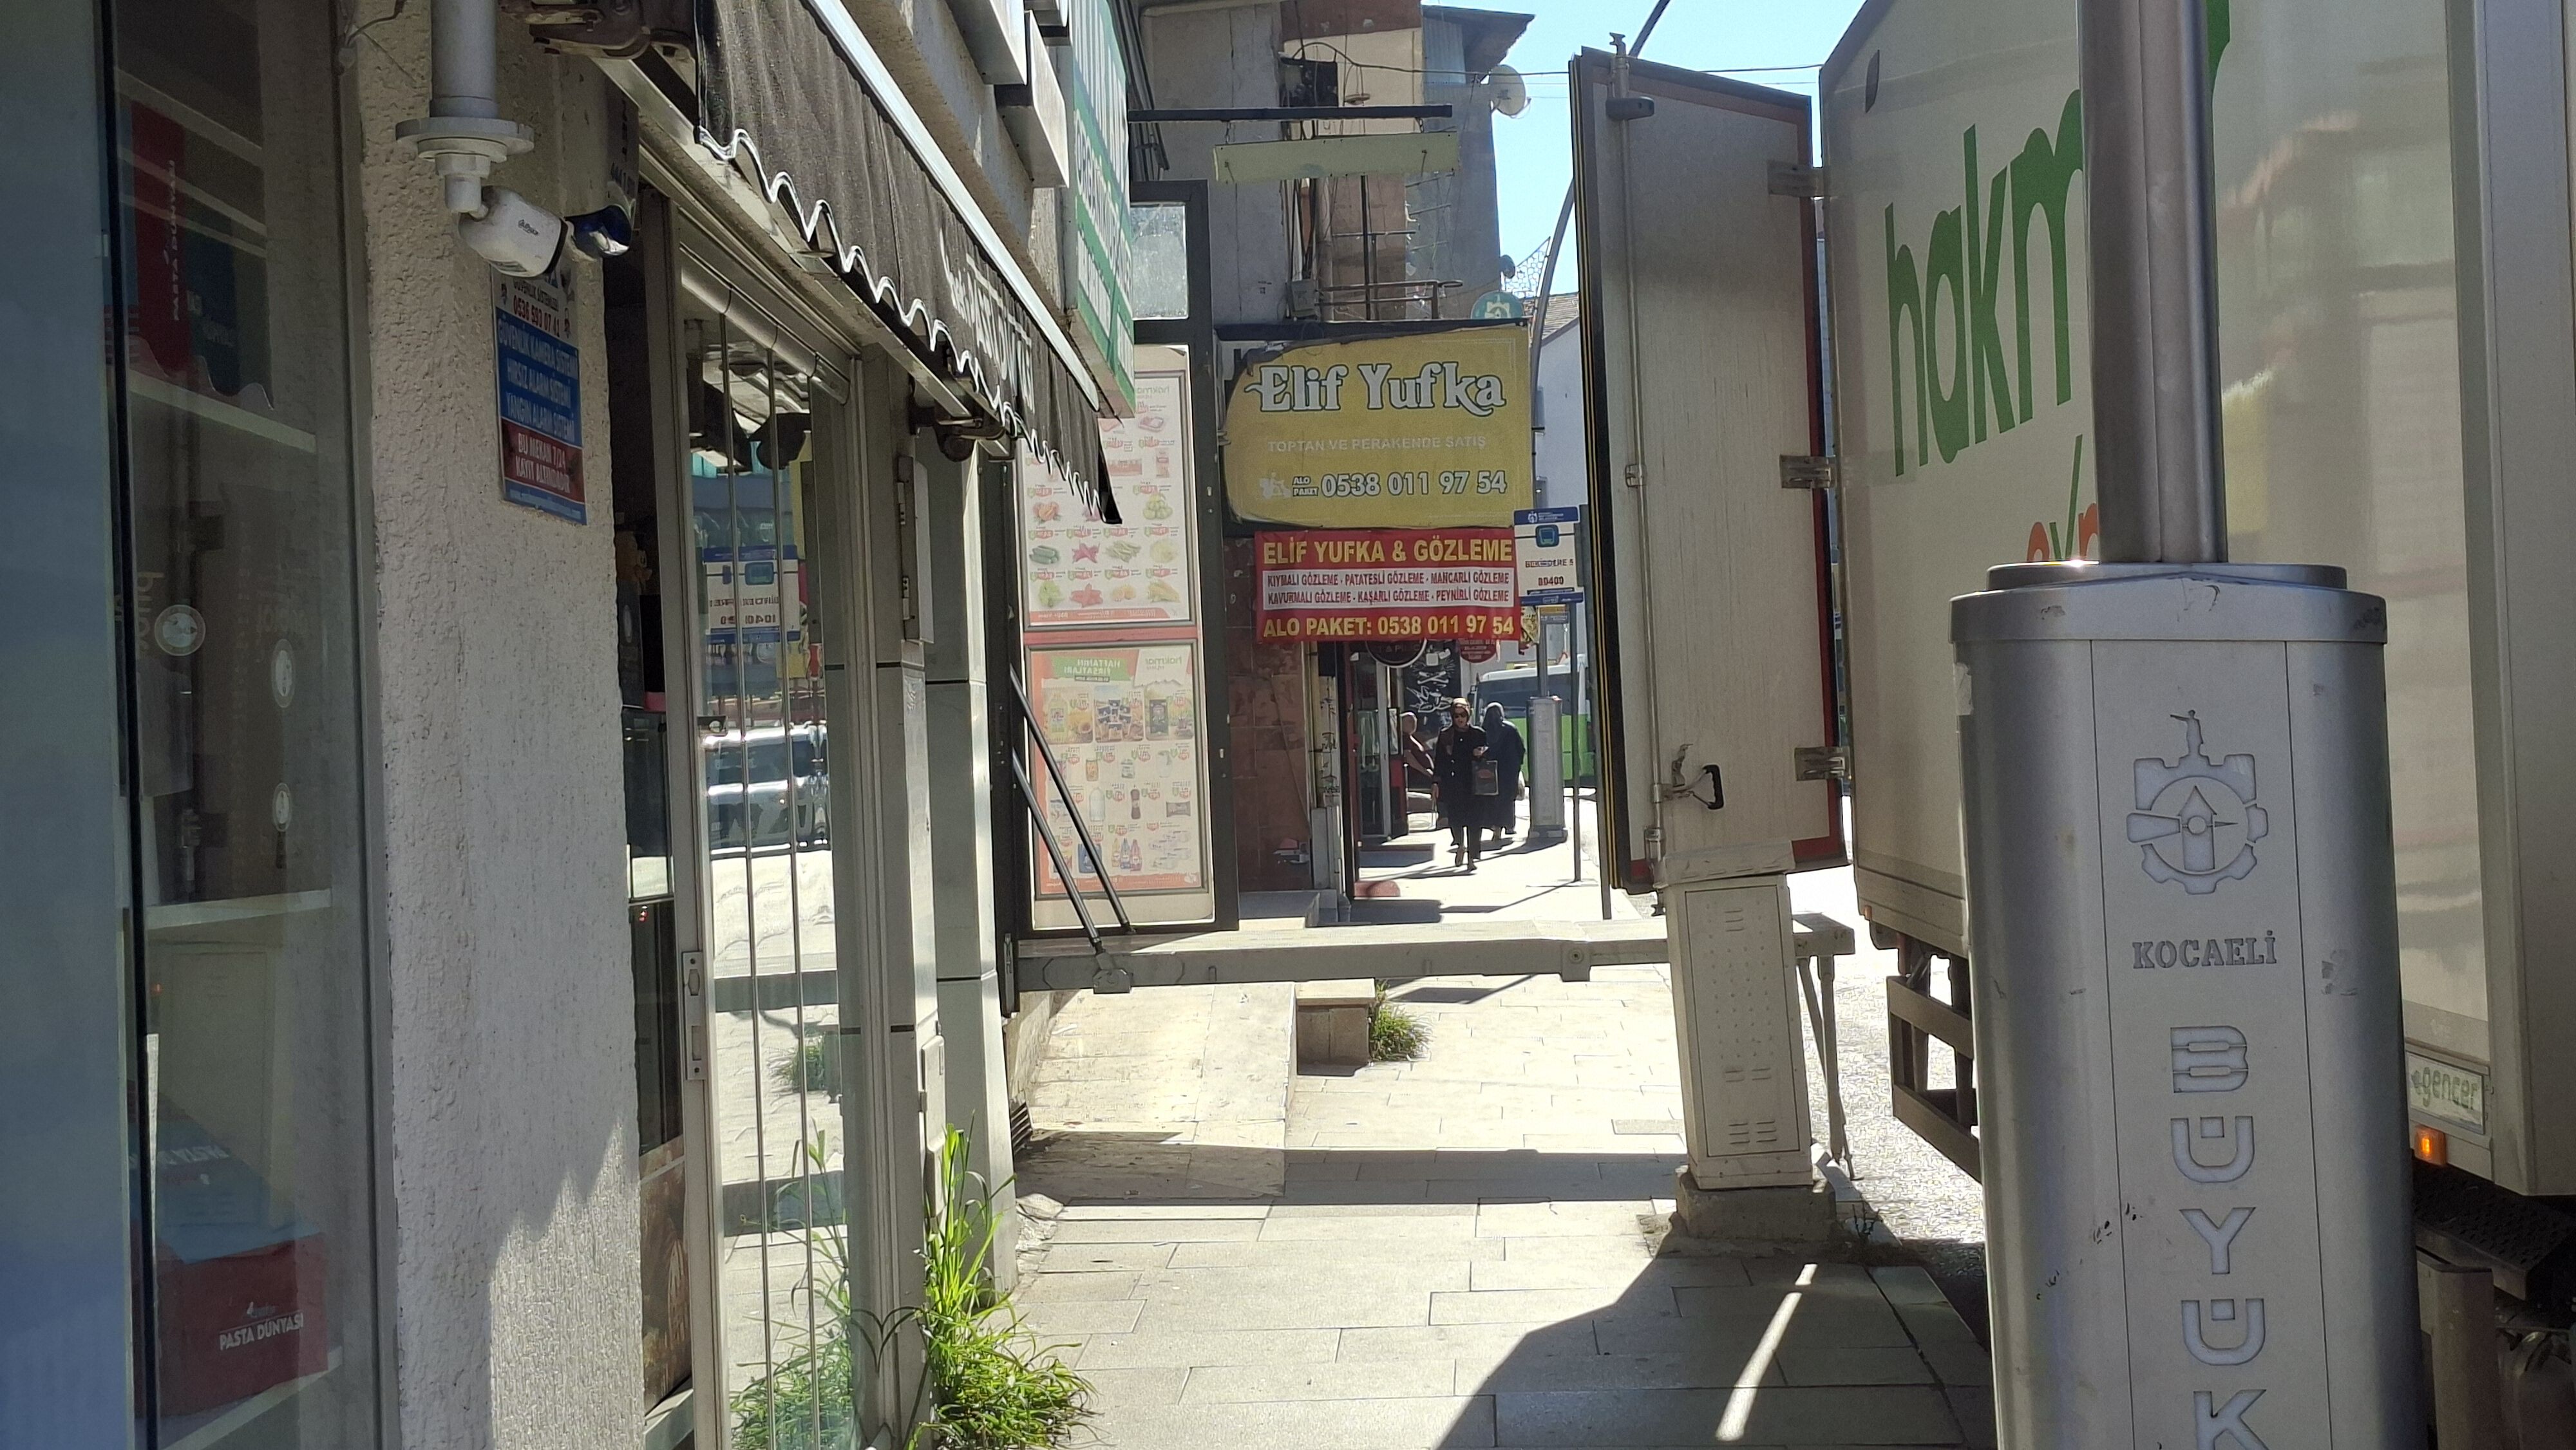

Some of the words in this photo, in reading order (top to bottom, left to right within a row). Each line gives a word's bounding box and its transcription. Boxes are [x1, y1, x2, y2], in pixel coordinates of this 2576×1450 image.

[1244, 364, 1349, 412] Elif
[1358, 361, 1507, 417] Yufka
[1268, 441, 1325, 452] TOPTAN
[1329, 440, 1347, 451] VE
[1352, 437, 1440, 450] PERAKENDE
[1292, 475, 1312, 485] ALO
[1321, 473, 1381, 497] 0538
[1387, 471, 1429, 496] 011
[1439, 470, 1470, 494] 97
[1477, 469, 1508, 494] 54
[1264, 536, 1307, 564] ELİF
[1314, 541, 1385, 563] YUFKA
[1392, 540, 1406, 561] &
[1414, 534, 1513, 561] GÖZLEME
[1267, 574, 1300, 587] KIYMALI
[1302, 572, 1338, 585] GÖZLEME
[1345, 570, 1385, 586] PATATESLİ
[1387, 570, 1425, 584] GÖZLEME
[1473, 570, 1510, 584] GÖZLEME
[1268, 591, 1312, 605] KAVURMALI
[1314, 589, 1351, 603] GÖZLEME
[1358, 590, 1390, 605] KAŞARLI
[1392, 588, 1430, 601] GÖZLEME
[1436, 587, 1472, 601] PEYNİRLİ
[1473, 588, 1509, 601] GÖZLEME
[1264, 617, 1300, 637] ALO
[1306, 617, 1372, 636] PAKET:
[1378, 616, 1421, 635] 0538
[1427, 615, 1459, 634] 011
[1466, 614, 1487, 634] 97
[1492, 616, 1514, 635] 54
[2133, 929, 2277, 969] KOCAELİ
[220, 1326, 255, 1351] PASTA
